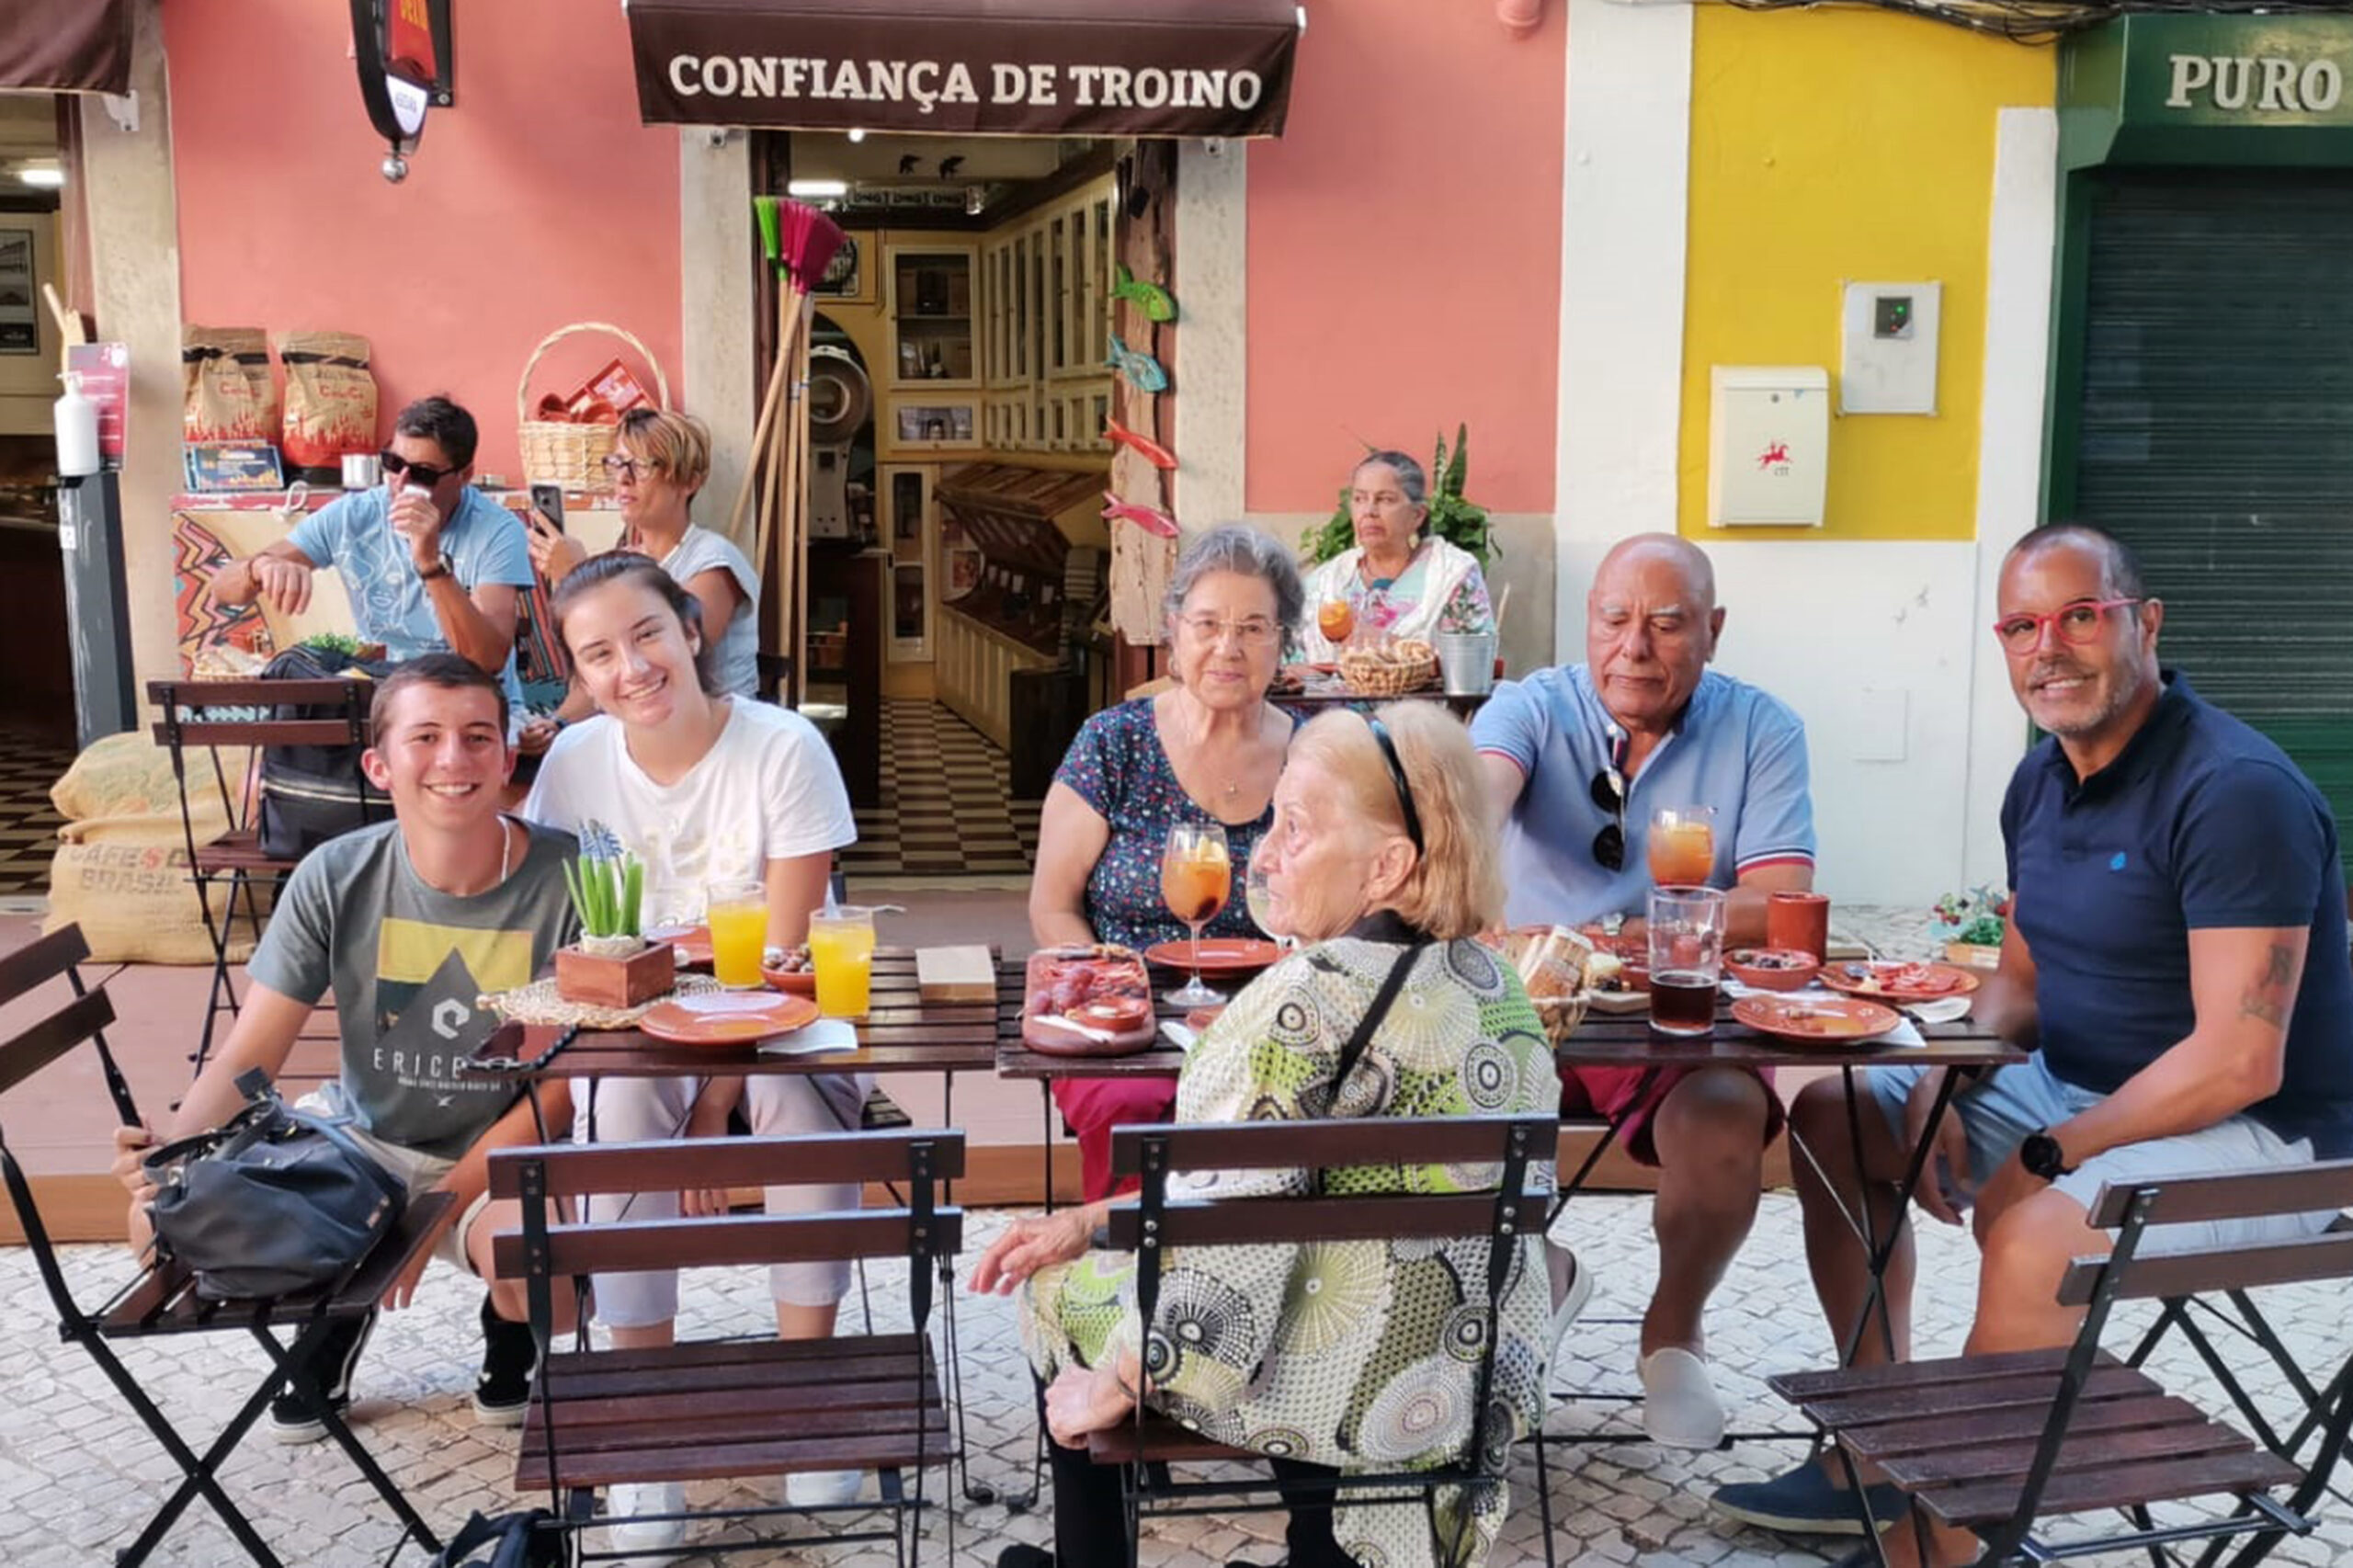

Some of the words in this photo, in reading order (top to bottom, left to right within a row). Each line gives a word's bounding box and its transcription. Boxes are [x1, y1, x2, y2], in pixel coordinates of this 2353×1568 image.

[668, 54, 978, 113] CONFIANÇA
[992, 63, 1057, 107] DE
[1068, 65, 1262, 110] TROINO
[2165, 54, 2342, 111] PURO
